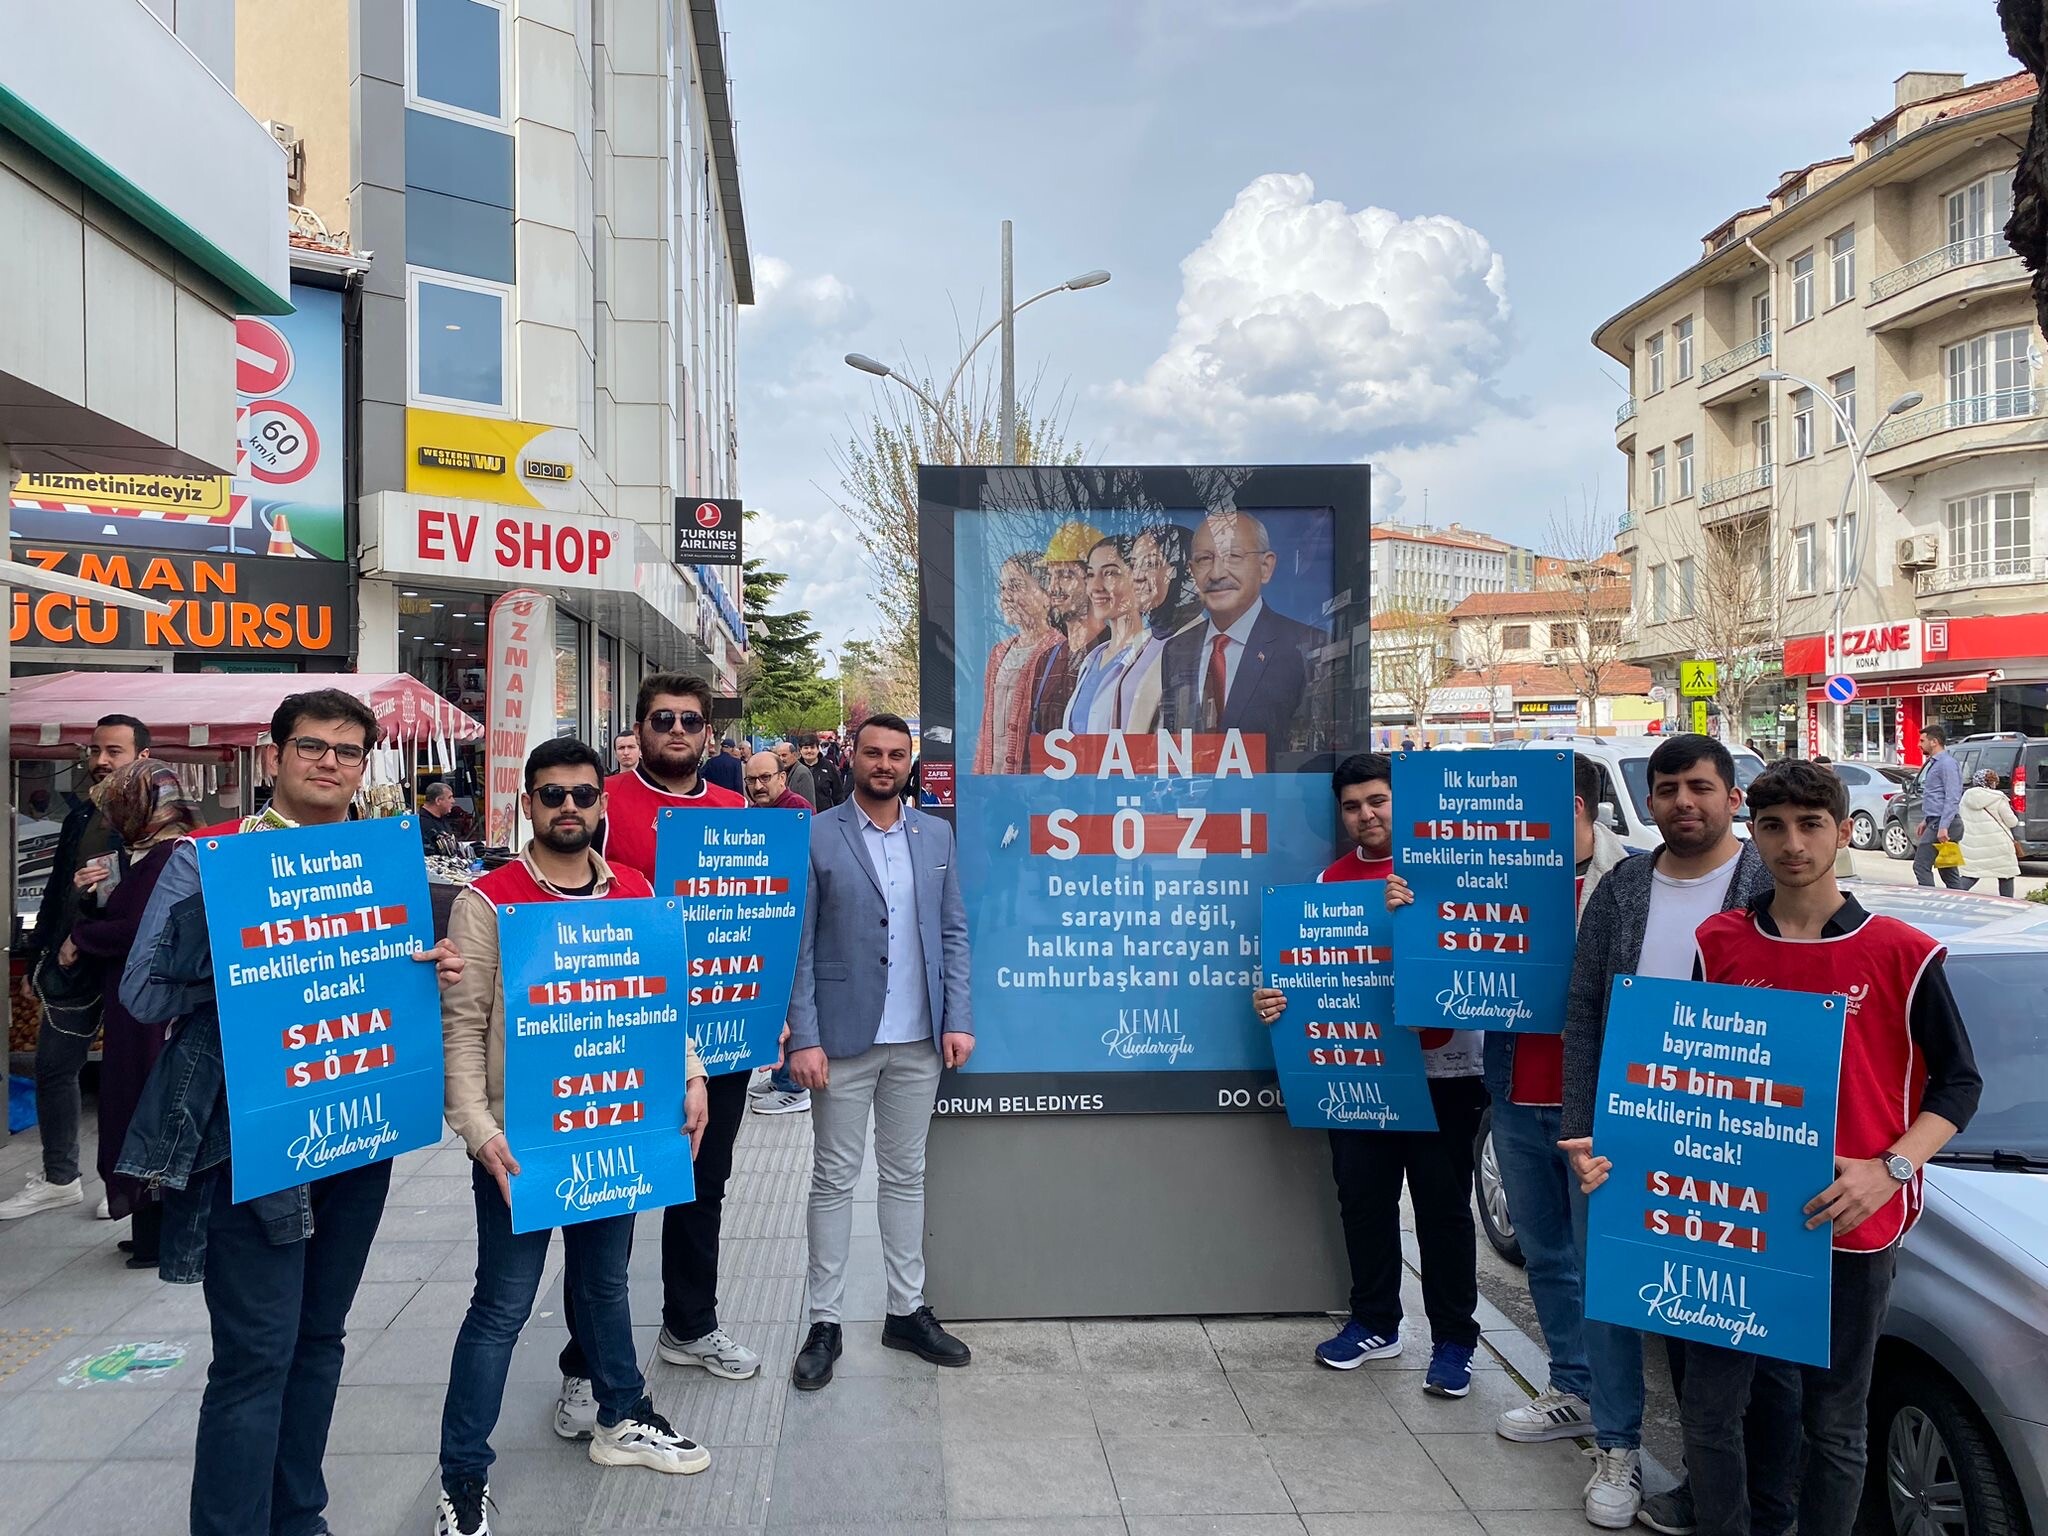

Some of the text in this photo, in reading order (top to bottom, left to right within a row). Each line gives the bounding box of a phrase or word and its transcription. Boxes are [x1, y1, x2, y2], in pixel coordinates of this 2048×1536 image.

[262, 419, 300, 455] 60
[249, 436, 277, 467] km/h
[423, 449, 470, 460] WESTERN
[438, 458, 470, 468] UNION
[418, 509, 611, 575] EV SHOP
[680, 529, 736, 540] TURKISH
[680, 540, 736, 550] AIRLINES
[10, 549, 236, 594] ZMAN
[144, 599, 332, 650] KURSU
[1856, 657, 1880, 668] KONAK
[1917, 682, 1955, 694] ECZANE
[1522, 704, 1576, 712] KULE TELEKOM
[1940, 704, 1978, 713] ECZANE
[1043, 728, 1254, 780] SANA
[1444, 768, 1518, 788] İlk kurban
[1439, 794, 1524, 815] bayramında
[704, 826, 766, 846] İlk kurban
[1046, 796, 1252, 860] SÖZ!
[1428, 820, 1535, 842] 15 bin TL
[270, 851, 362, 878] İlk kurban
[699, 851, 768, 872] bayramında
[1402, 847, 1564, 868] Emeklilerin hesabında
[268, 876, 373, 910] bayramında
[688, 876, 776, 898] 15 bin TL
[1049, 876, 1248, 900] Devletin parasını
[1457, 872, 1508, 890] olacak!
[737, 901, 796, 920] hesabında
[1062, 905, 1236, 932] sarayına değil,
[1304, 901, 1364, 919] İlk kurban
[1443, 901, 1524, 924] SANA
[259, 906, 391, 948] 15 bin TL
[558, 922, 633, 945] İlk kurban
[708, 926, 751, 944] olacak!
[1300, 922, 1368, 942] bayramında
[1028, 936, 1113, 957] halkına
[1124, 935, 1229, 960] harcayan
[1444, 928, 1524, 954] SÖZ!
[229, 935, 424, 986] Emeklilerin hesabında
[554, 950, 640, 974] bayramında
[692, 954, 758, 977] SANA
[1292, 946, 1380, 966] 15 bin TL
[304, 973, 366, 1004] olacak!
[544, 976, 652, 1006] 15 bin TL
[997, 966, 1178, 992] Cumhurbaşkanı
[1272, 972, 1338, 989] Emeklilerin
[1454, 970, 1520, 998] KEMAL
[690, 982, 756, 1006] SÖZ!
[1318, 993, 1360, 1010] olacak!
[288, 1008, 388, 1050] SANA
[516, 1004, 678, 1037] Emeklilerin hesabında
[1119, 1008, 1182, 1034] KEMAL
[1672, 1001, 1767, 1036] İlk kurban
[695, 1018, 747, 1048] KEMAL
[1309, 1022, 1378, 1040] SANA
[574, 1036, 626, 1059] olacak!
[1314, 1044, 1381, 1066] SÖZ!
[1663, 1032, 1771, 1066] bayramında
[293, 1044, 390, 1088] SÖZ!
[558, 1068, 640, 1098] SANA
[1328, 1082, 1386, 1105] KEMAL
[1646, 1062, 1782, 1108] 15 bin TL
[1000, 1094, 1104, 1112] BELEDIYES
[1218, 1089, 1250, 1107] DO
[309, 1092, 386, 1140] KEMAL
[558, 1100, 640, 1133] SÖZ!
[1608, 1093, 1819, 1147] Emeklilerin hesabında
[1674, 1135, 1742, 1166] olacak!
[572, 1145, 640, 1184] KEMAL
[1652, 1171, 1761, 1214] SANA
[1652, 1208, 1758, 1253] SÖZ!
[1663, 1260, 1752, 1310] KEMAL
